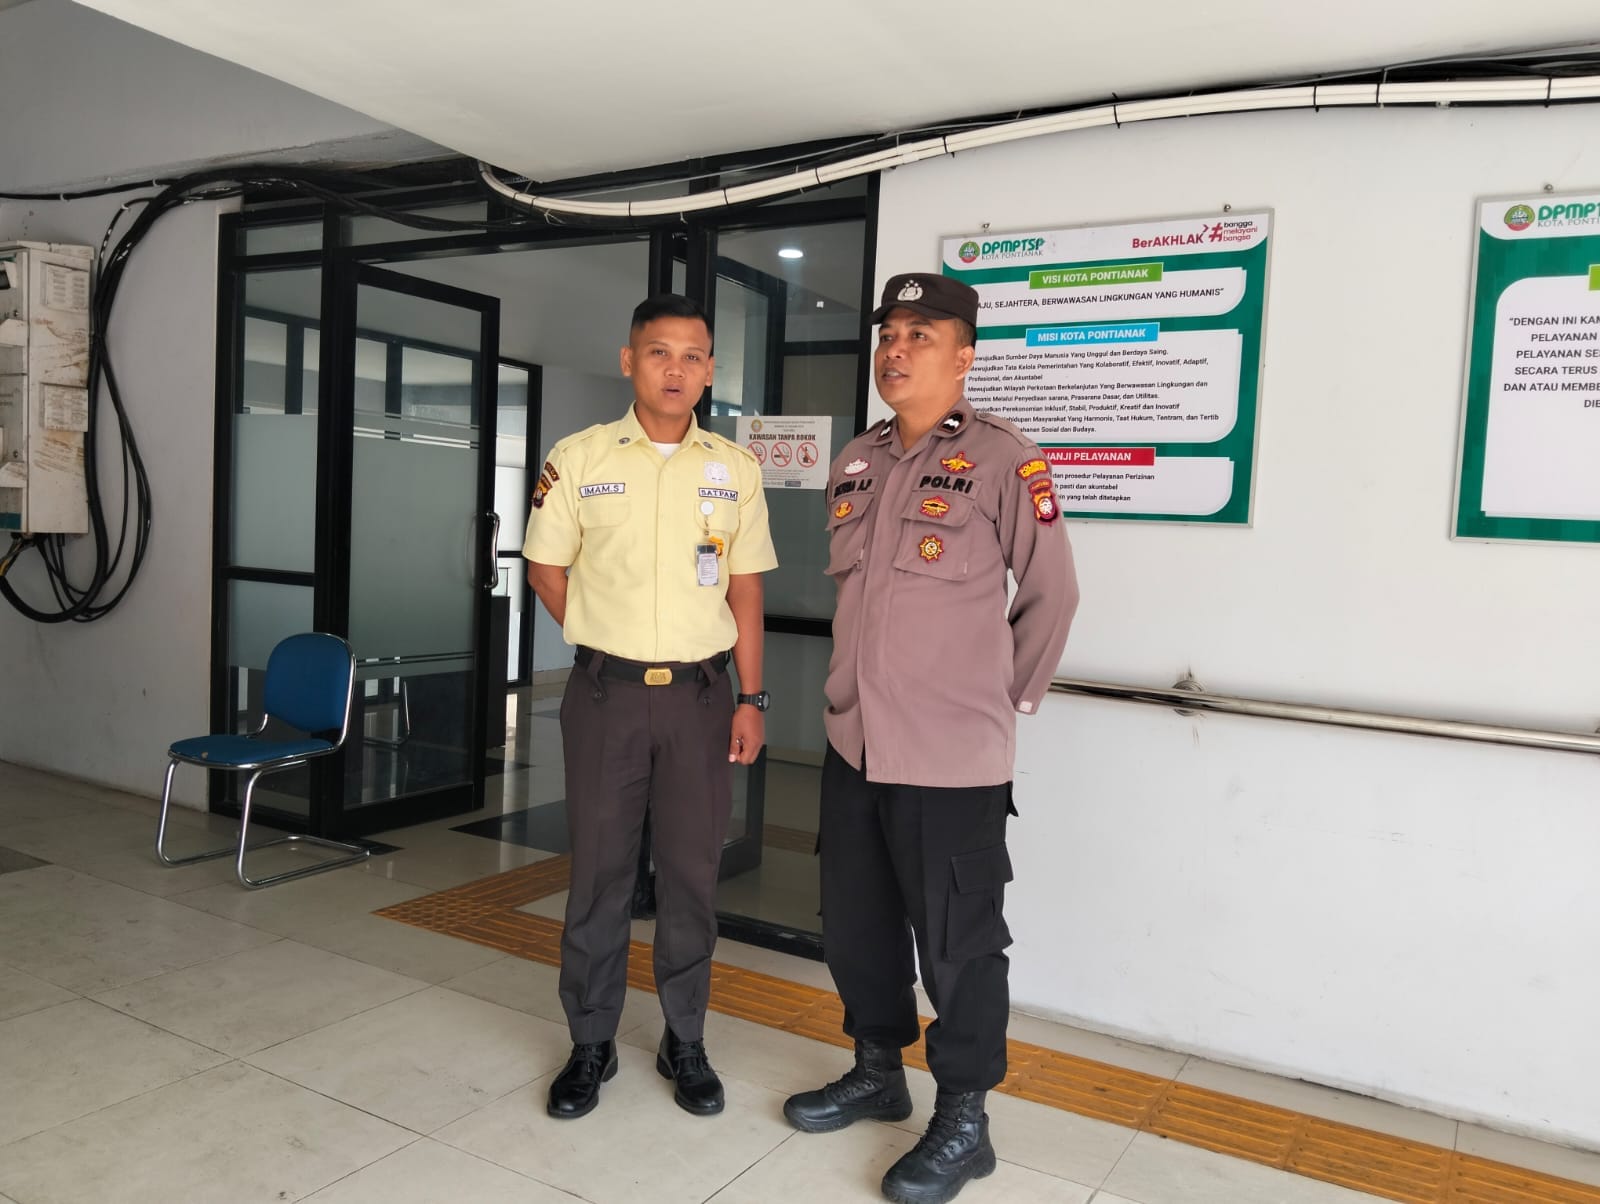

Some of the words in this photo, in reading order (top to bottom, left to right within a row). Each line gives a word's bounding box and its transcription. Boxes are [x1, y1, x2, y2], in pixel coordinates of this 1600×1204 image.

[1224, 220, 1253, 229] bangga
[1538, 219, 1564, 228] KOTA
[1568, 217, 1600, 226] PONTI
[1223, 227, 1258, 237] melayani
[1132, 233, 1205, 249] BerAKHLAK
[1223, 234, 1251, 242] bangsa
[981, 237, 1045, 255] DPMPTSP
[981, 253, 999, 261] KOTA
[1001, 249, 1044, 260] PONTIANAK
[1042, 274, 1061, 284] VISI
[1063, 273, 1088, 283] KOTA
[1090, 268, 1149, 280] PONTIANAK
[994, 299, 1040, 309] SEJAHTERA,
[1041, 295, 1098, 306] BERWAWASAN
[1099, 292, 1153, 303] LINGKUNGAN
[1154, 290, 1178, 299] YANG
[1562, 316, 1577, 325] INI
[1037, 333, 1058, 343] MISI
[1061, 331, 1086, 341] KOTA
[1088, 328, 1146, 340] PONTIANAK
[1530, 332, 1598, 342] PELAYANAN
[1029, 353, 1043, 361] Daya
[1070, 352, 1086, 360] Yang
[1086, 351, 1107, 359] Unggul
[1122, 350, 1148, 358] Berdaya
[1516, 349, 1582, 359] PELAYANAN
[1584, 349, 1600, 358] SE
[1037, 362, 1078, 370] Pemerintahan
[1079, 362, 1095, 370] Yang
[1514, 366, 1559, 375] SECARA
[1561, 365, 1598, 375] TERUS
[1003, 385, 1026, 393] Wilayah
[1057, 383, 1099, 391] Berkelanjutan
[1157, 381, 1194, 390] Lingkungan
[1503, 383, 1527, 392] DAN
[1529, 383, 1559, 392] ATAU
[1120, 403, 1141, 411] Kreatif
[1067, 415, 1082, 423] Yang
[1199, 413, 1220, 421] Tertib
[749, 433, 777, 441] KAWASAN
[778, 433, 795, 441] TANPA
[1074, 452, 1132, 461] PELAYANAN
[1064, 473, 1091, 481] prosedur
[1092, 473, 1124, 481] Pelayanan
[919, 475, 974, 494] POLRI
[1059, 483, 1074, 491] pasti
[700, 489, 737, 500] SATPAM
[1098, 494, 1131, 502] ditetapkan
